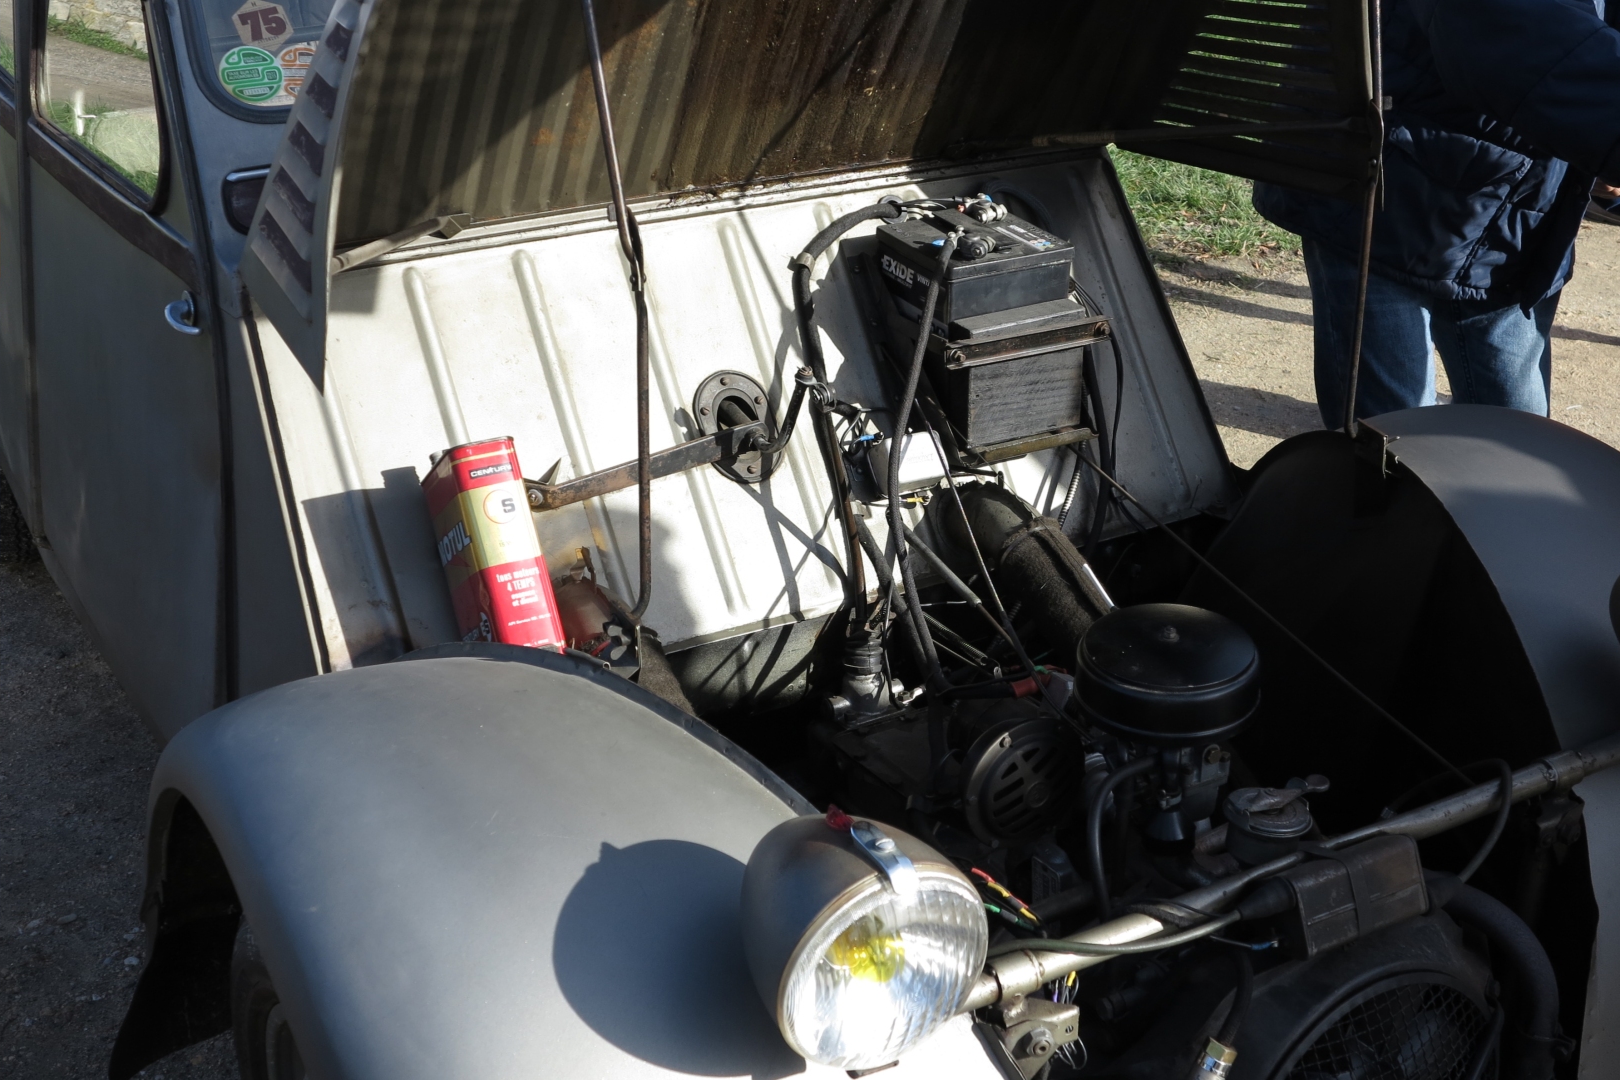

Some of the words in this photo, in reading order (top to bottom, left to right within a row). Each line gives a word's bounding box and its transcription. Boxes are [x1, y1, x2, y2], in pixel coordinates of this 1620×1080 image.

[237, 6, 287, 42] 75
[470, 463, 512, 478] CENTURY
[501, 498, 516, 513] S
[507, 582, 513, 592] 4
[512, 577, 536, 590] TEMPS
